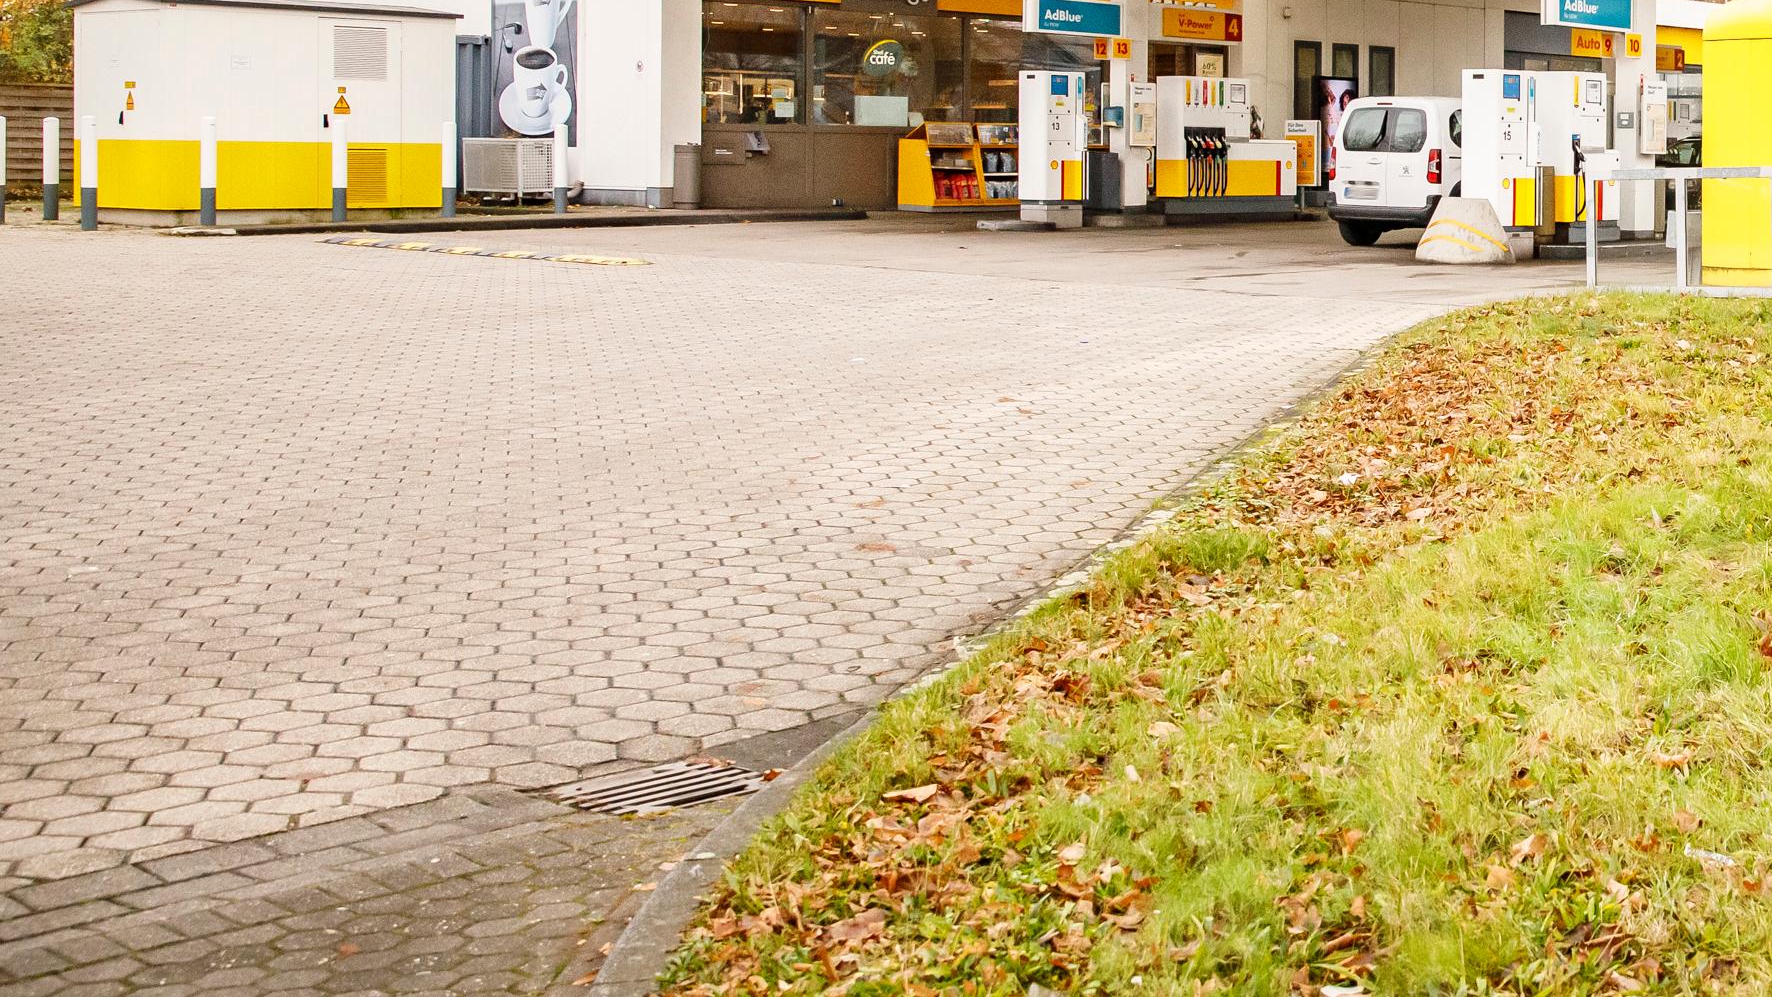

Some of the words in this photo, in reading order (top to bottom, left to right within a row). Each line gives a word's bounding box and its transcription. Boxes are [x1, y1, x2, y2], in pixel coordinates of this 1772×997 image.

[1044, 9, 1083, 23] AdBlue
[1228, 18, 1238, 36] 4
[1096, 42, 1107, 55] 12
[1117, 43, 1128, 55] 13
[1576, 36, 1600, 50] Auto
[1604, 38, 1612, 52] 9
[1630, 39, 1640, 52] 10
[870, 52, 896, 65] café
[1676, 53, 1684, 68] 2
[1503, 131, 1511, 141] 15
